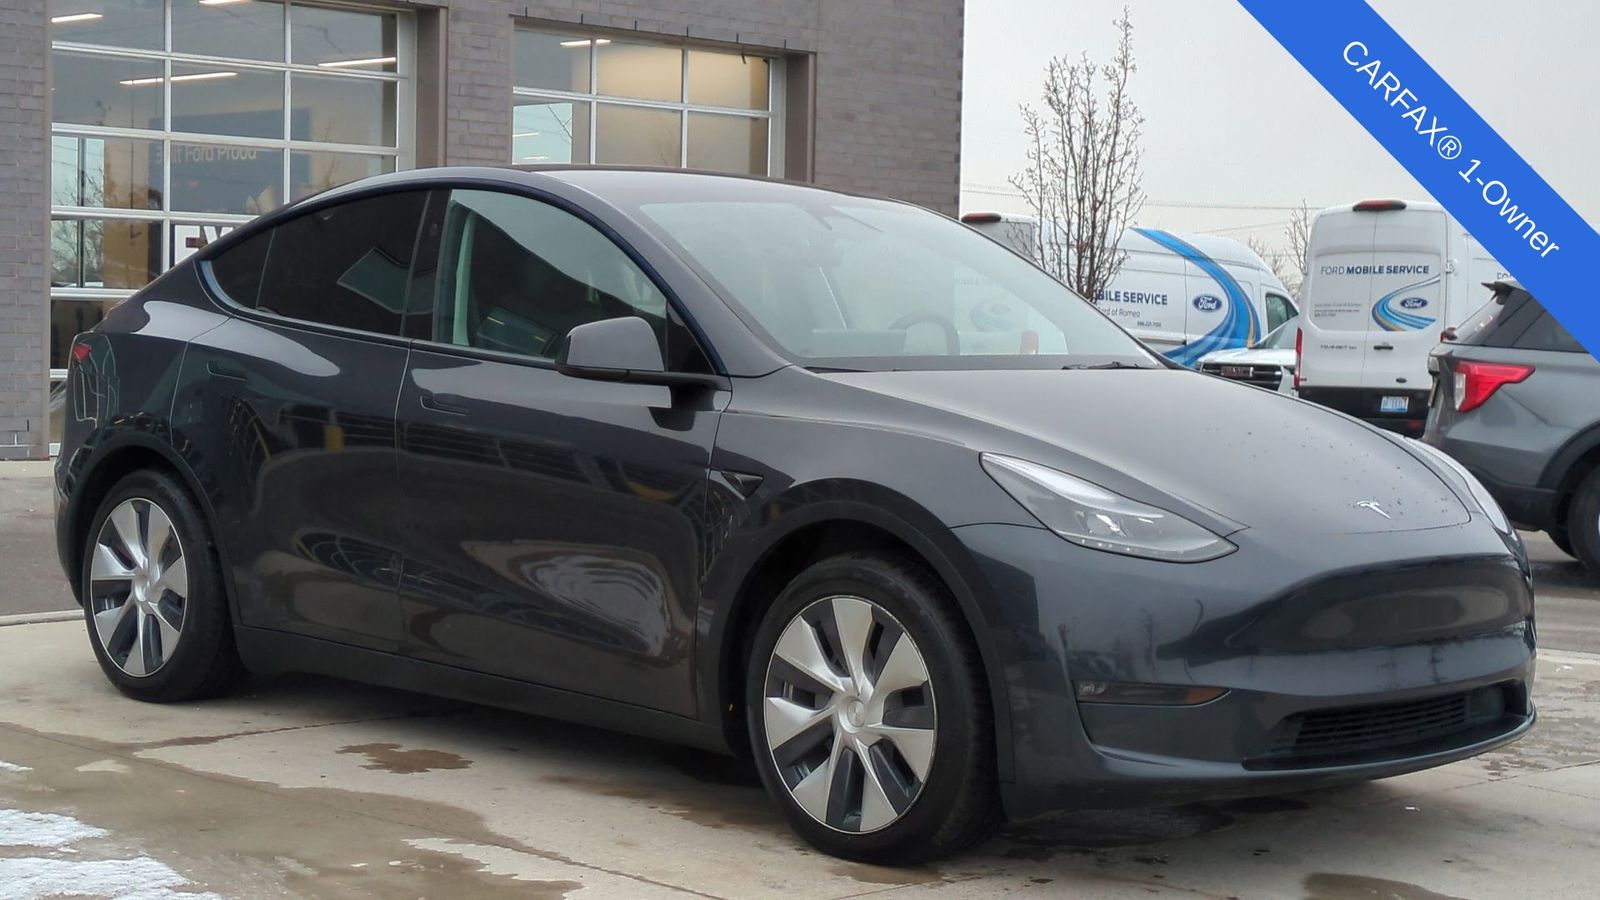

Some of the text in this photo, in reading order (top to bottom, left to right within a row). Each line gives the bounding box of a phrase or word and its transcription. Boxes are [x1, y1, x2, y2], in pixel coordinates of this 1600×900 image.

[1321, 265, 1430, 275] FORD MOBILE SERVICE
[1123, 291, 1168, 305] SERVICE
[1197, 296, 1218, 310] Ford
